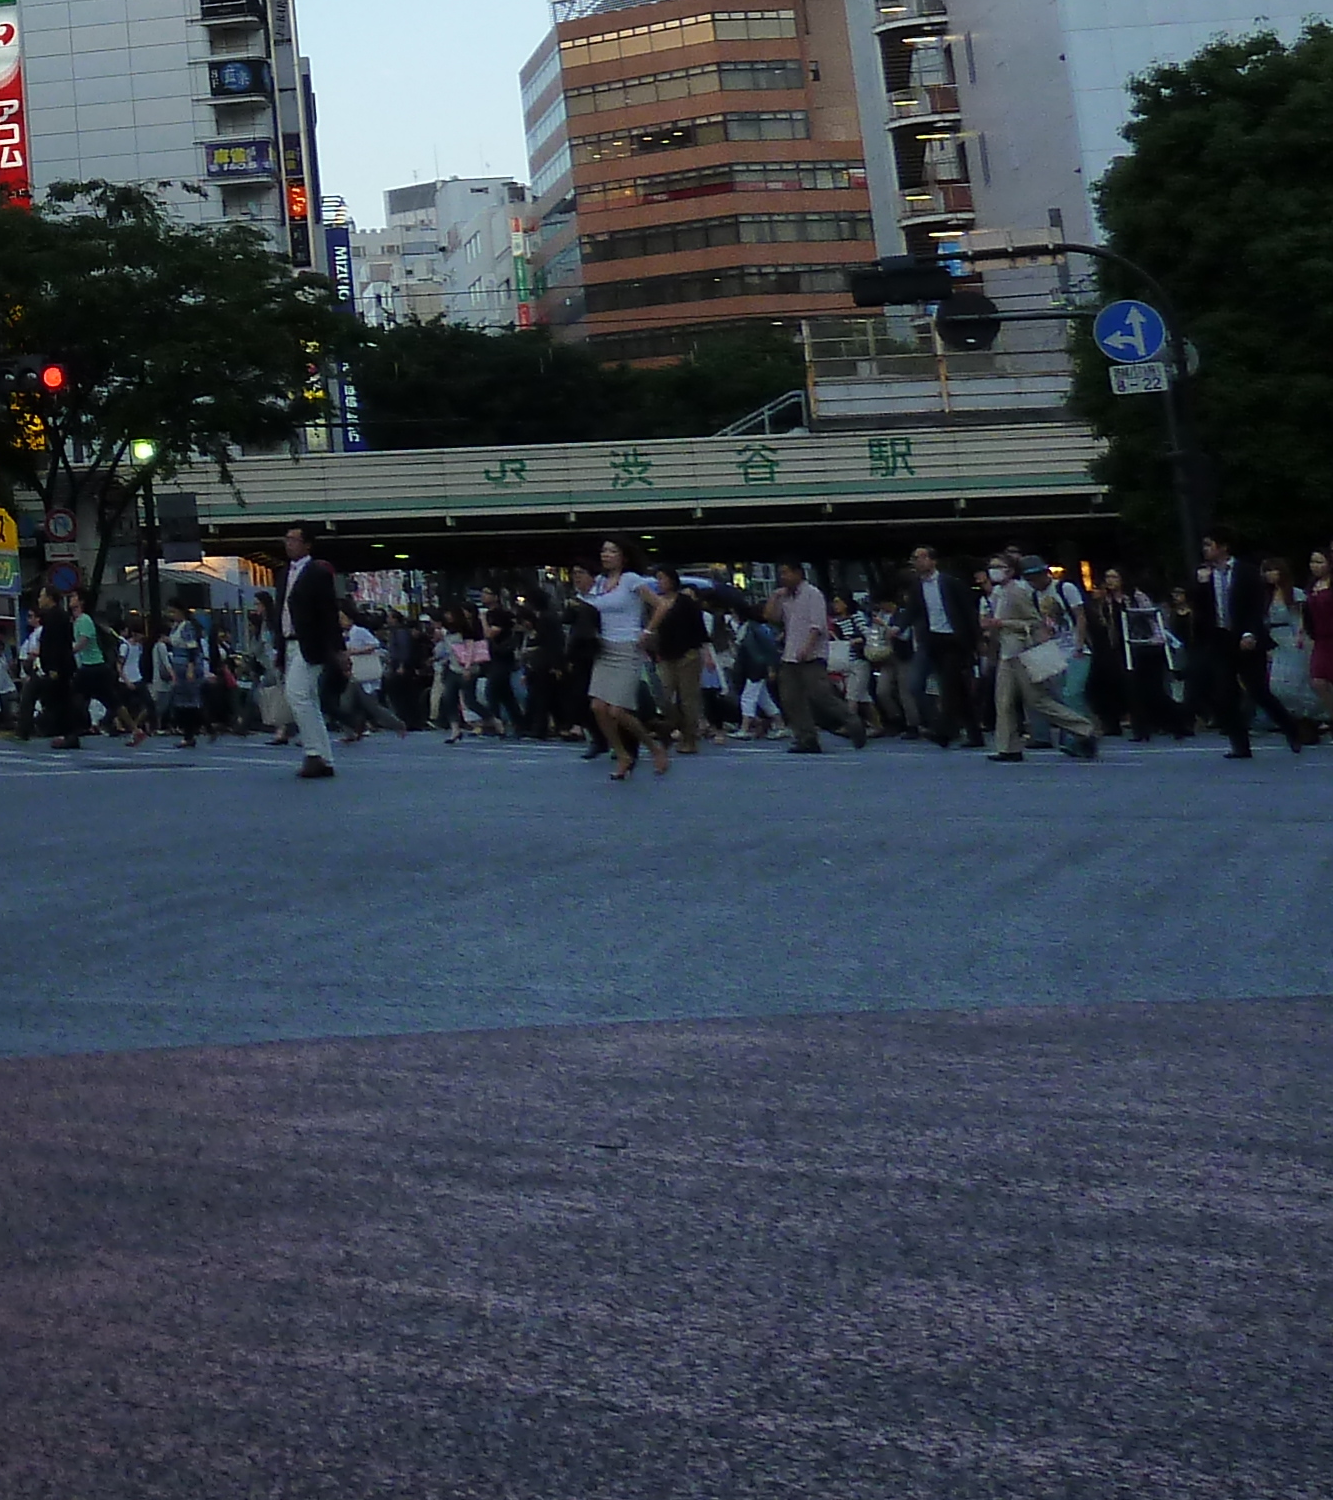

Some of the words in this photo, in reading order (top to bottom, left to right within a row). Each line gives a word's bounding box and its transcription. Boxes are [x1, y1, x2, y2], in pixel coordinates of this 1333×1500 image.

[485, 458, 528, 488] JR
[610, 435, 916, 488] 渋谷駅
